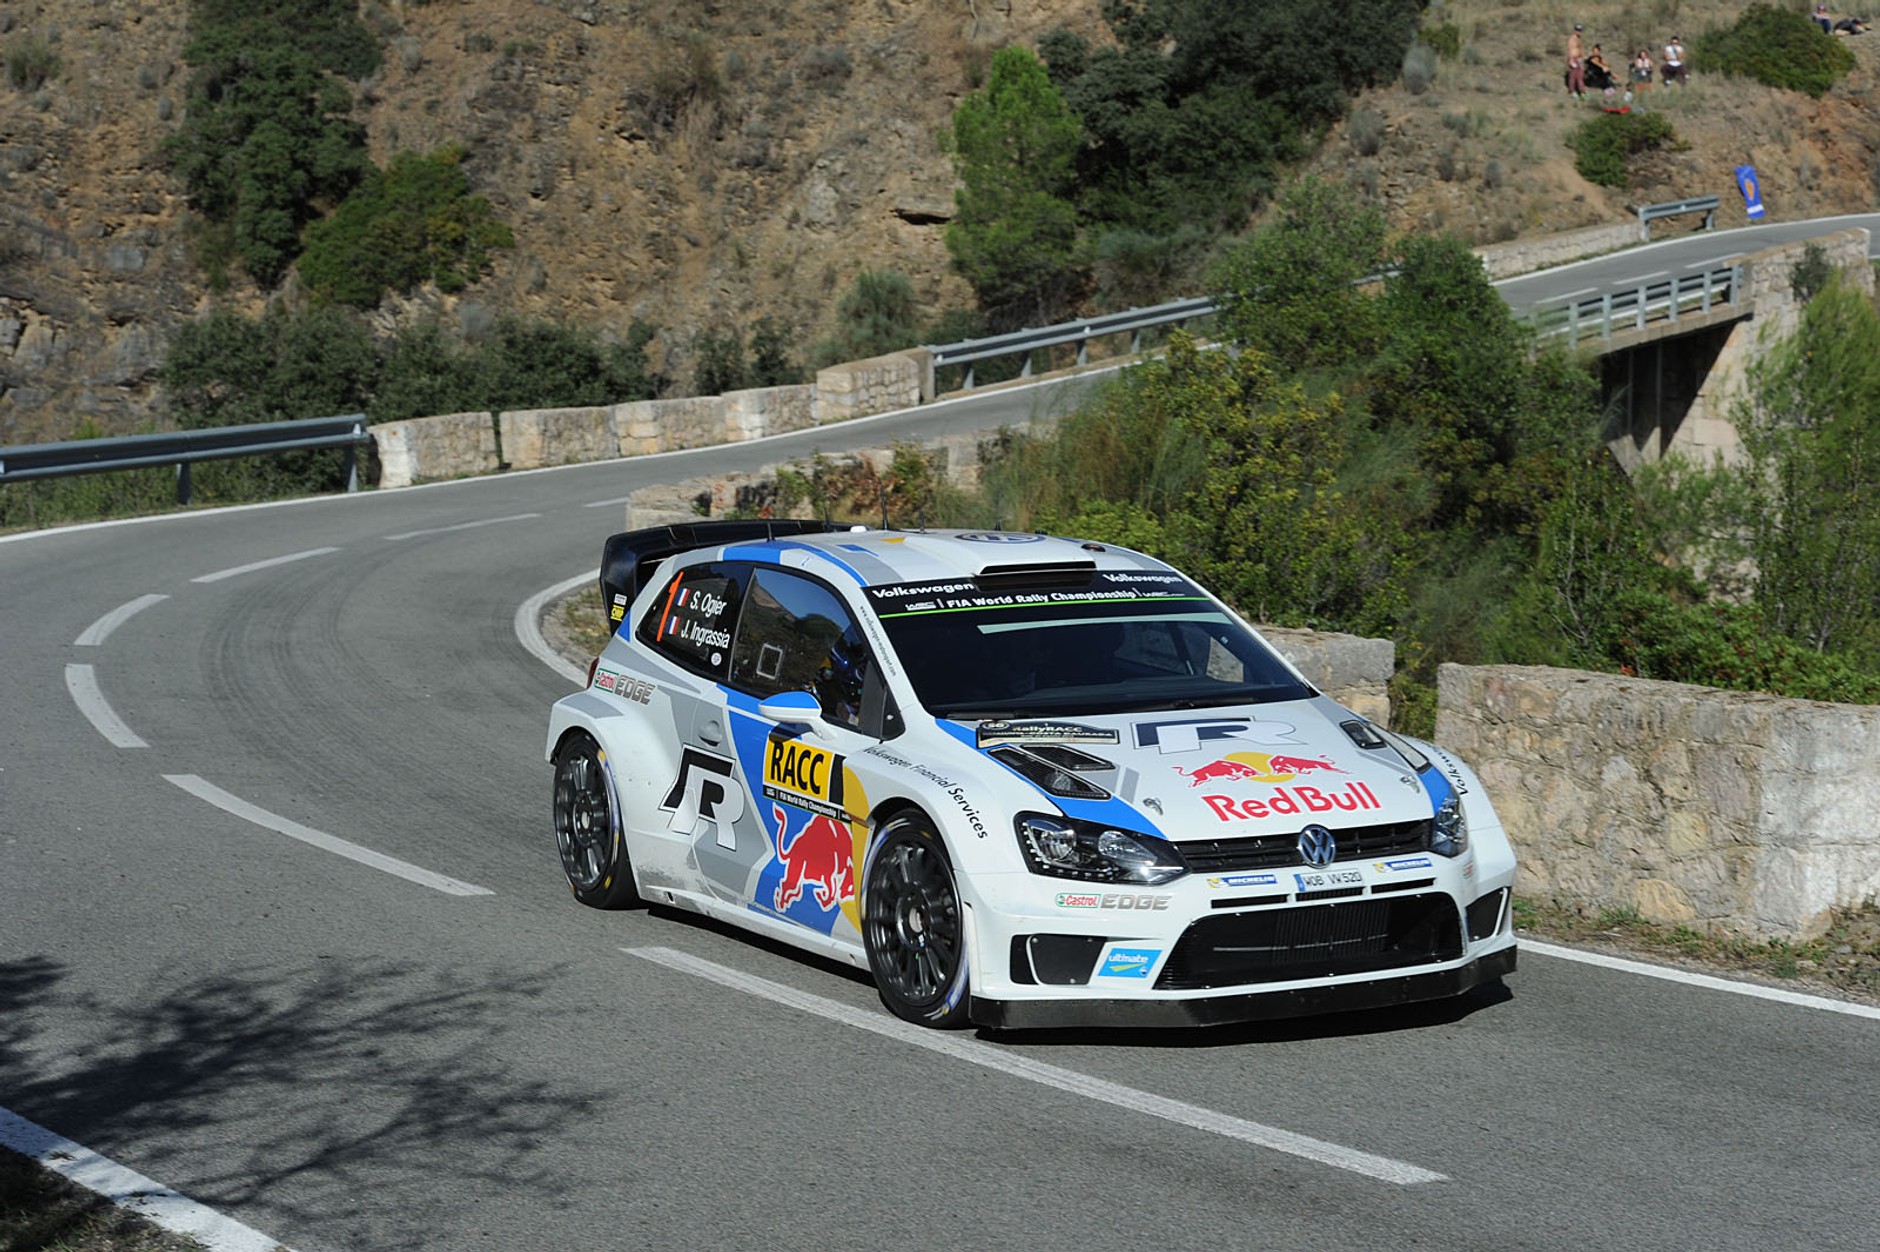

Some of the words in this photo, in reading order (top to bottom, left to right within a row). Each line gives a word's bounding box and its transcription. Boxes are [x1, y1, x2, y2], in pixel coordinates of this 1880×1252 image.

[872, 582, 974, 598] Volkswagen
[1102, 573, 1183, 584] Volkswagen
[690, 590, 701, 610] S.
[701, 593, 727, 618] Ogier
[946, 598, 972, 608] FIA
[972, 595, 1014, 607] World
[1015, 594, 1049, 603] Rally
[1050, 589, 1137, 601] Championship
[680, 619, 688, 639] J.
[689, 621, 731, 649] Ingrassia
[614, 674, 656, 706] EDGE
[771, 741, 824, 795] RACC
[910, 764, 957, 788] Financial
[948, 787, 988, 839] Services
[1201, 786, 1300, 822] Red
[1292, 782, 1382, 812] Bull
[1065, 894, 1098, 906] Castrol
[1100, 893, 1172, 910] EDGE
